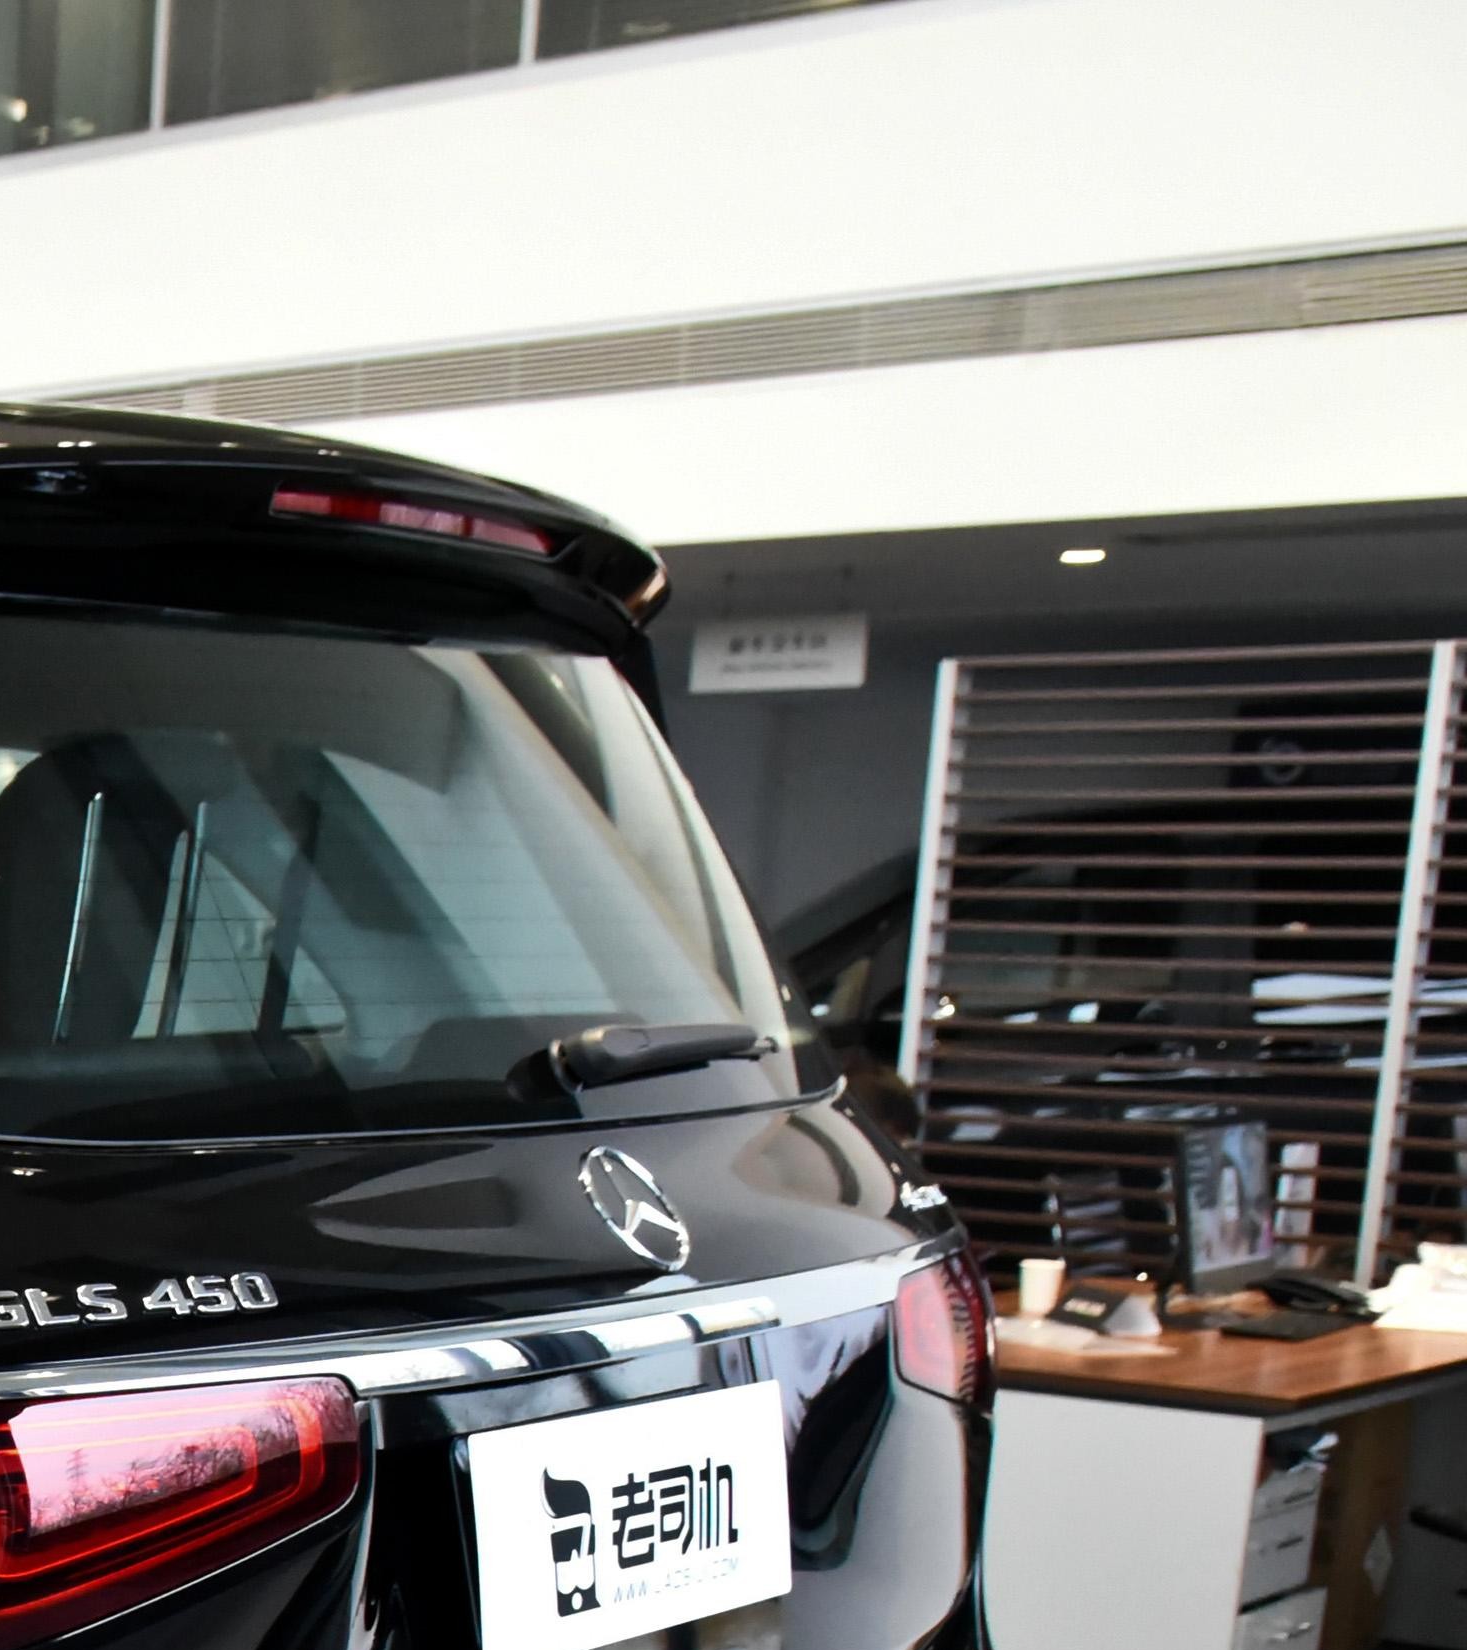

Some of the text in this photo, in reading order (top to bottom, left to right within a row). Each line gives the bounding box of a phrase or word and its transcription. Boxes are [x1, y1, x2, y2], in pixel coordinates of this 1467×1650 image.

[142, 1271, 279, 1316] 450
[612, 1457, 739, 1570] 老司机
